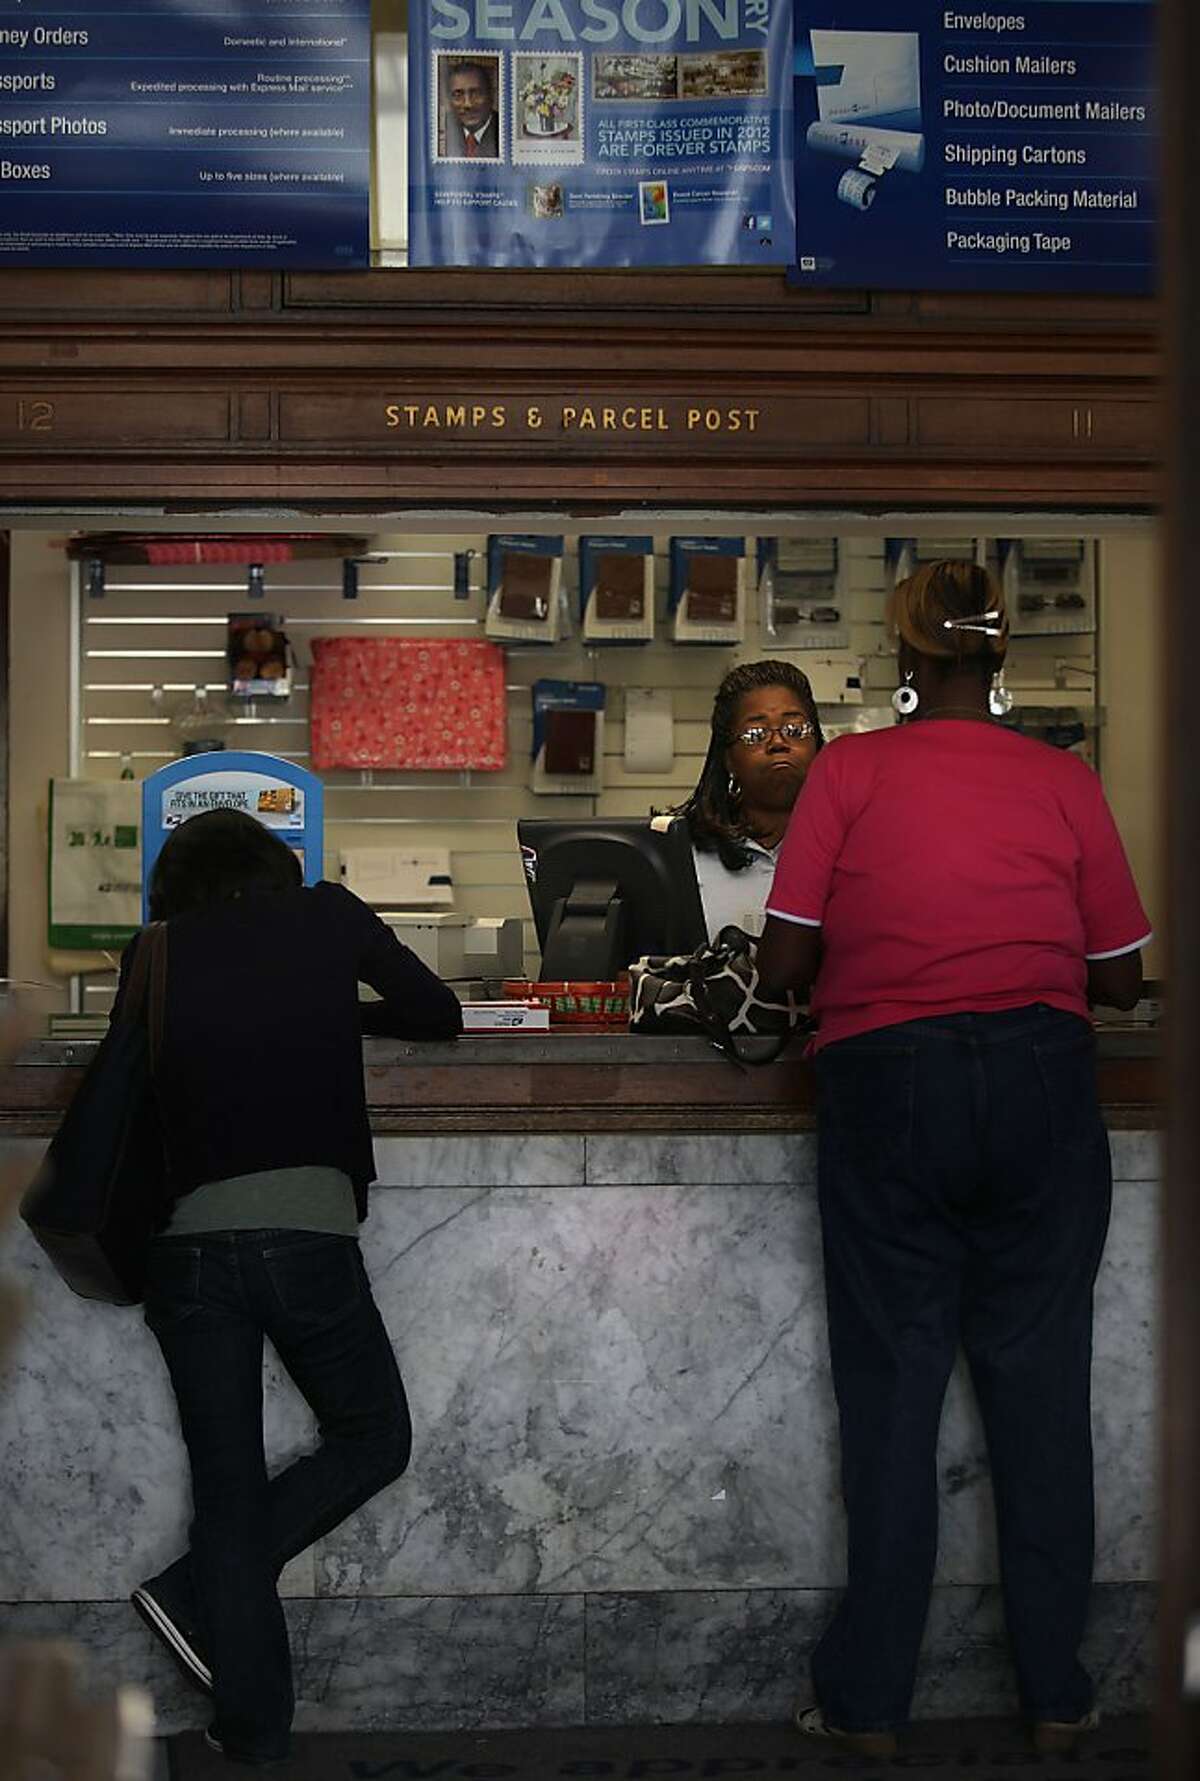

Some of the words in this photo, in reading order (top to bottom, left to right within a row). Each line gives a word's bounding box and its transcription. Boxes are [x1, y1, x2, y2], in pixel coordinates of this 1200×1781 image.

[430, 0, 739, 43] SEASON
[943, 12, 1025, 32] Envelopes
[34, 26, 89, 45] Orders
[223, 36, 266, 46] Domestic
[268, 36, 287, 46] and
[943, 55, 1010, 74] Cushion
[1015, 56, 1077, 75] Mailers
[130, 81, 177, 92] Expedited
[178, 83, 228, 93] processing
[229, 82, 250, 92] with
[257, 73, 292, 82] Routine
[943, 100, 1081, 120] Photo/Document
[1085, 102, 1146, 121] Mailers
[51, 116, 107, 135] Photos
[598, 119, 616, 129] ALL
[680, 116, 770, 128] COMMEMORATIVE
[169, 127, 217, 137] Immediate
[218, 127, 268, 138] processing
[598, 130, 656, 142] STAMPS
[661, 128, 713, 142] ISSUED
[717, 127, 732, 140] IN
[737, 126, 770, 139] 2012
[598, 144, 629, 157] ARE
[633, 142, 705, 156] FOREVER
[709, 140, 770, 154] STAMPS
[944, 145, 1017, 166] Shipping
[1022, 146, 1086, 164] Cartons
[1, 160, 51, 179] Boxes
[199, 171, 213, 182] Up
[214, 171, 225, 181] to
[225, 171, 243, 181] five
[945, 189, 1001, 207] Bubble
[1005, 189, 1068, 210] Packing
[1073, 190, 1138, 208] Material
[946, 231, 1030, 253] Packaging
[1033, 232, 1071, 252] Tape
[17, 402, 54, 431] 12
[384, 405, 506, 428] STAMPS
[526, 407, 542, 428] &
[562, 407, 670, 430] PARCEL
[687, 408, 760, 431] POST
[194, 791, 207, 800] THE
